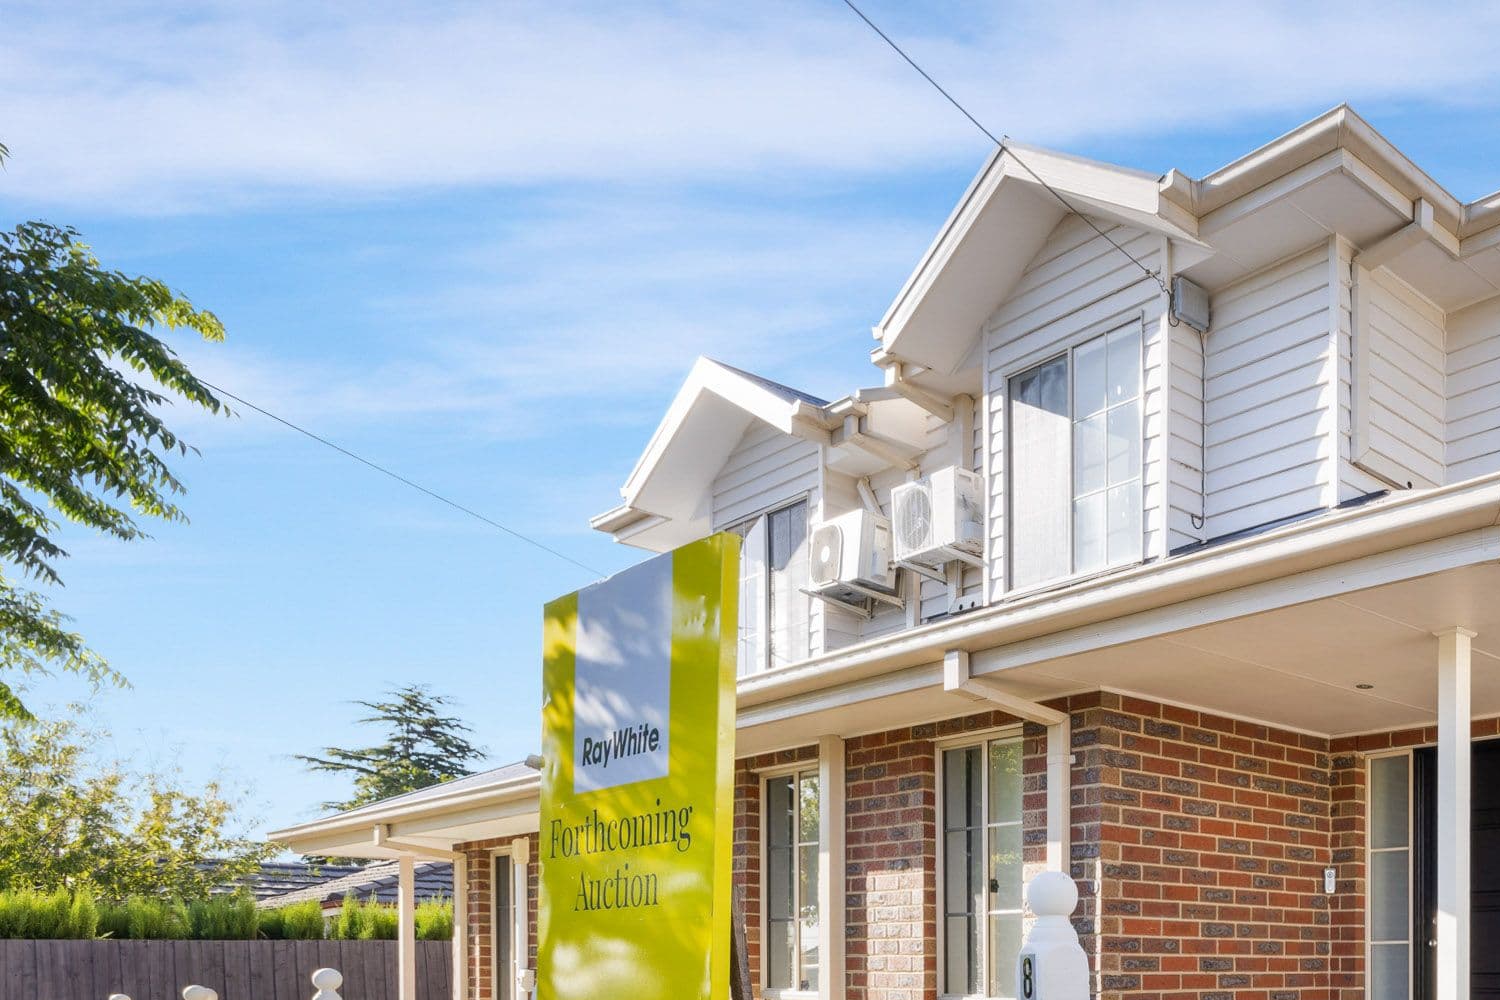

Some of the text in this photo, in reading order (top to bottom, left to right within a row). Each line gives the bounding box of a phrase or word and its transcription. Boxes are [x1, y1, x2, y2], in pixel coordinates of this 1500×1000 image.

[550, 799, 692, 859] Forthcoming
[574, 863, 658, 912] Auction
[1022, 957, 1033, 999] 8
